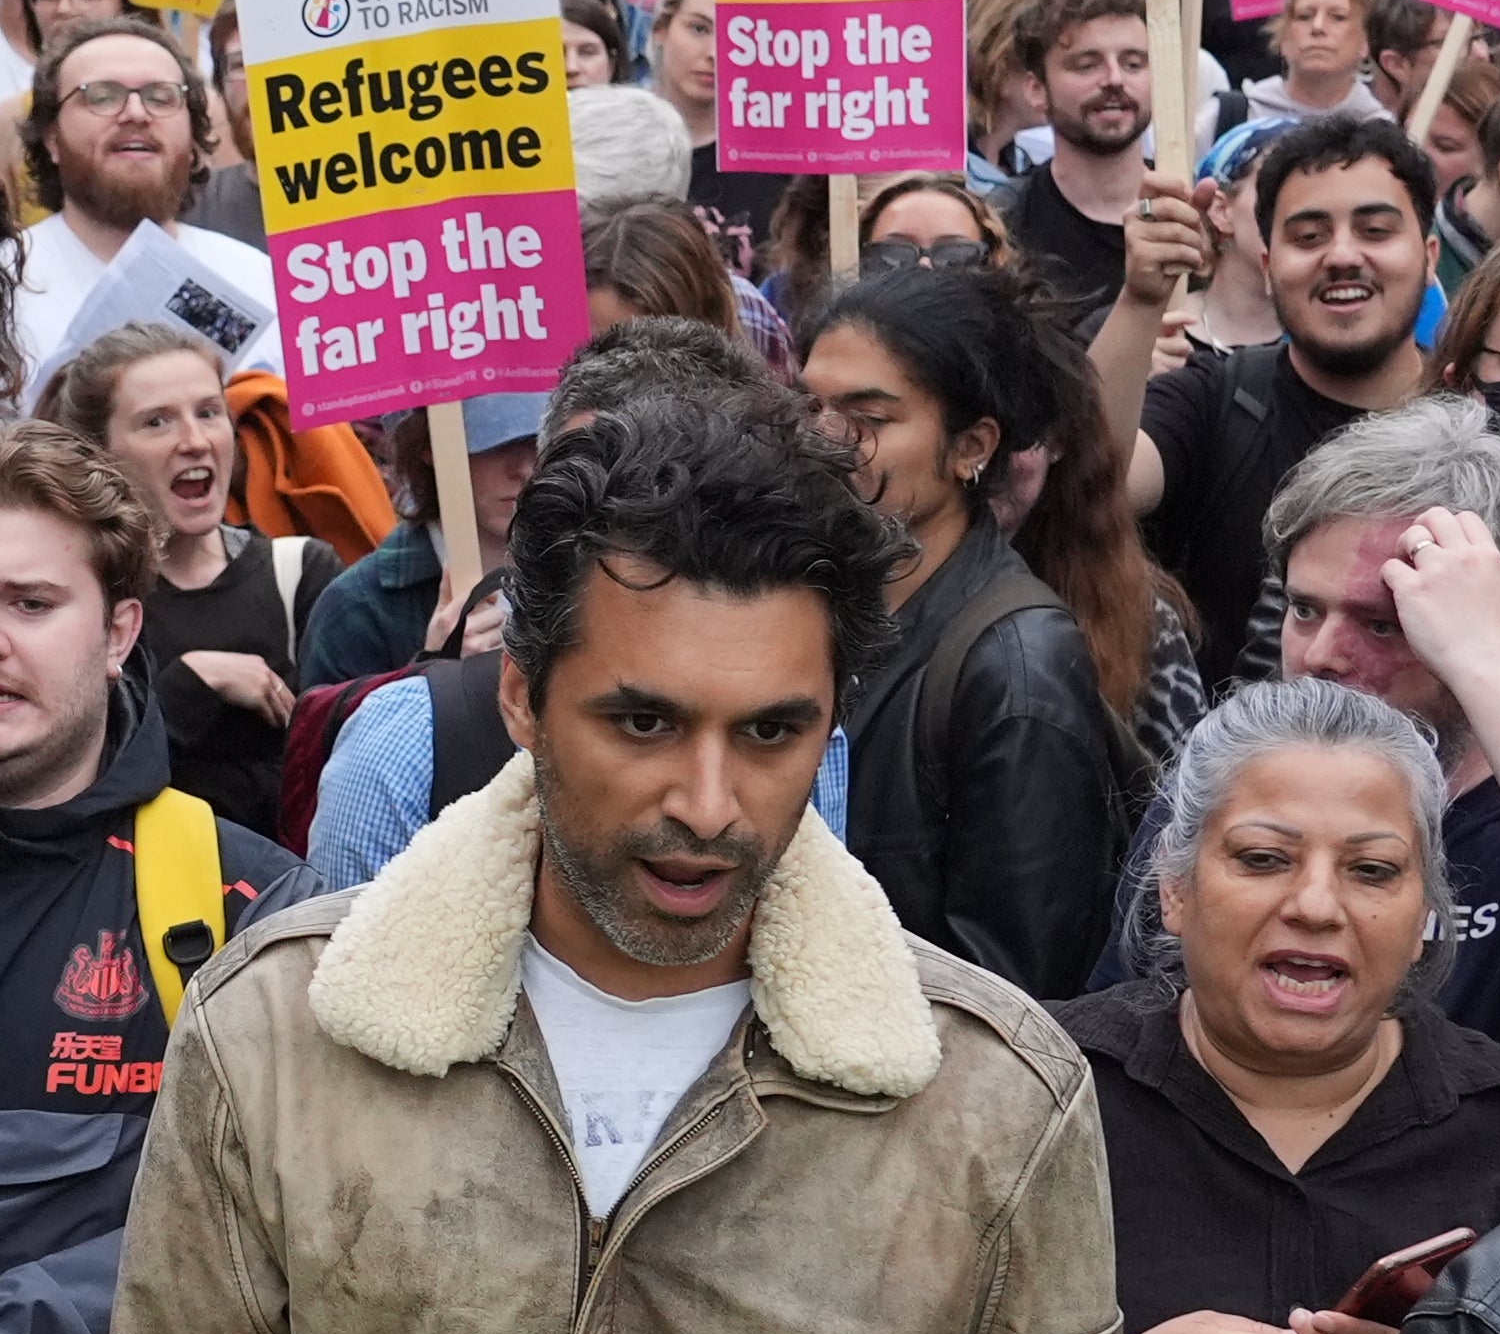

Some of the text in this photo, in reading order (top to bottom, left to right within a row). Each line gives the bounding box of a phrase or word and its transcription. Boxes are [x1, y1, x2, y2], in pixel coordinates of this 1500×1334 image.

[358, 7, 390, 30] TO
[265, 51, 549, 135] Refugees
[275, 124, 541, 204] welcome
[286, 211, 542, 305] Stop the
[296, 283, 547, 377] far right
[49, 1032, 123, 1060] 乐天堂
